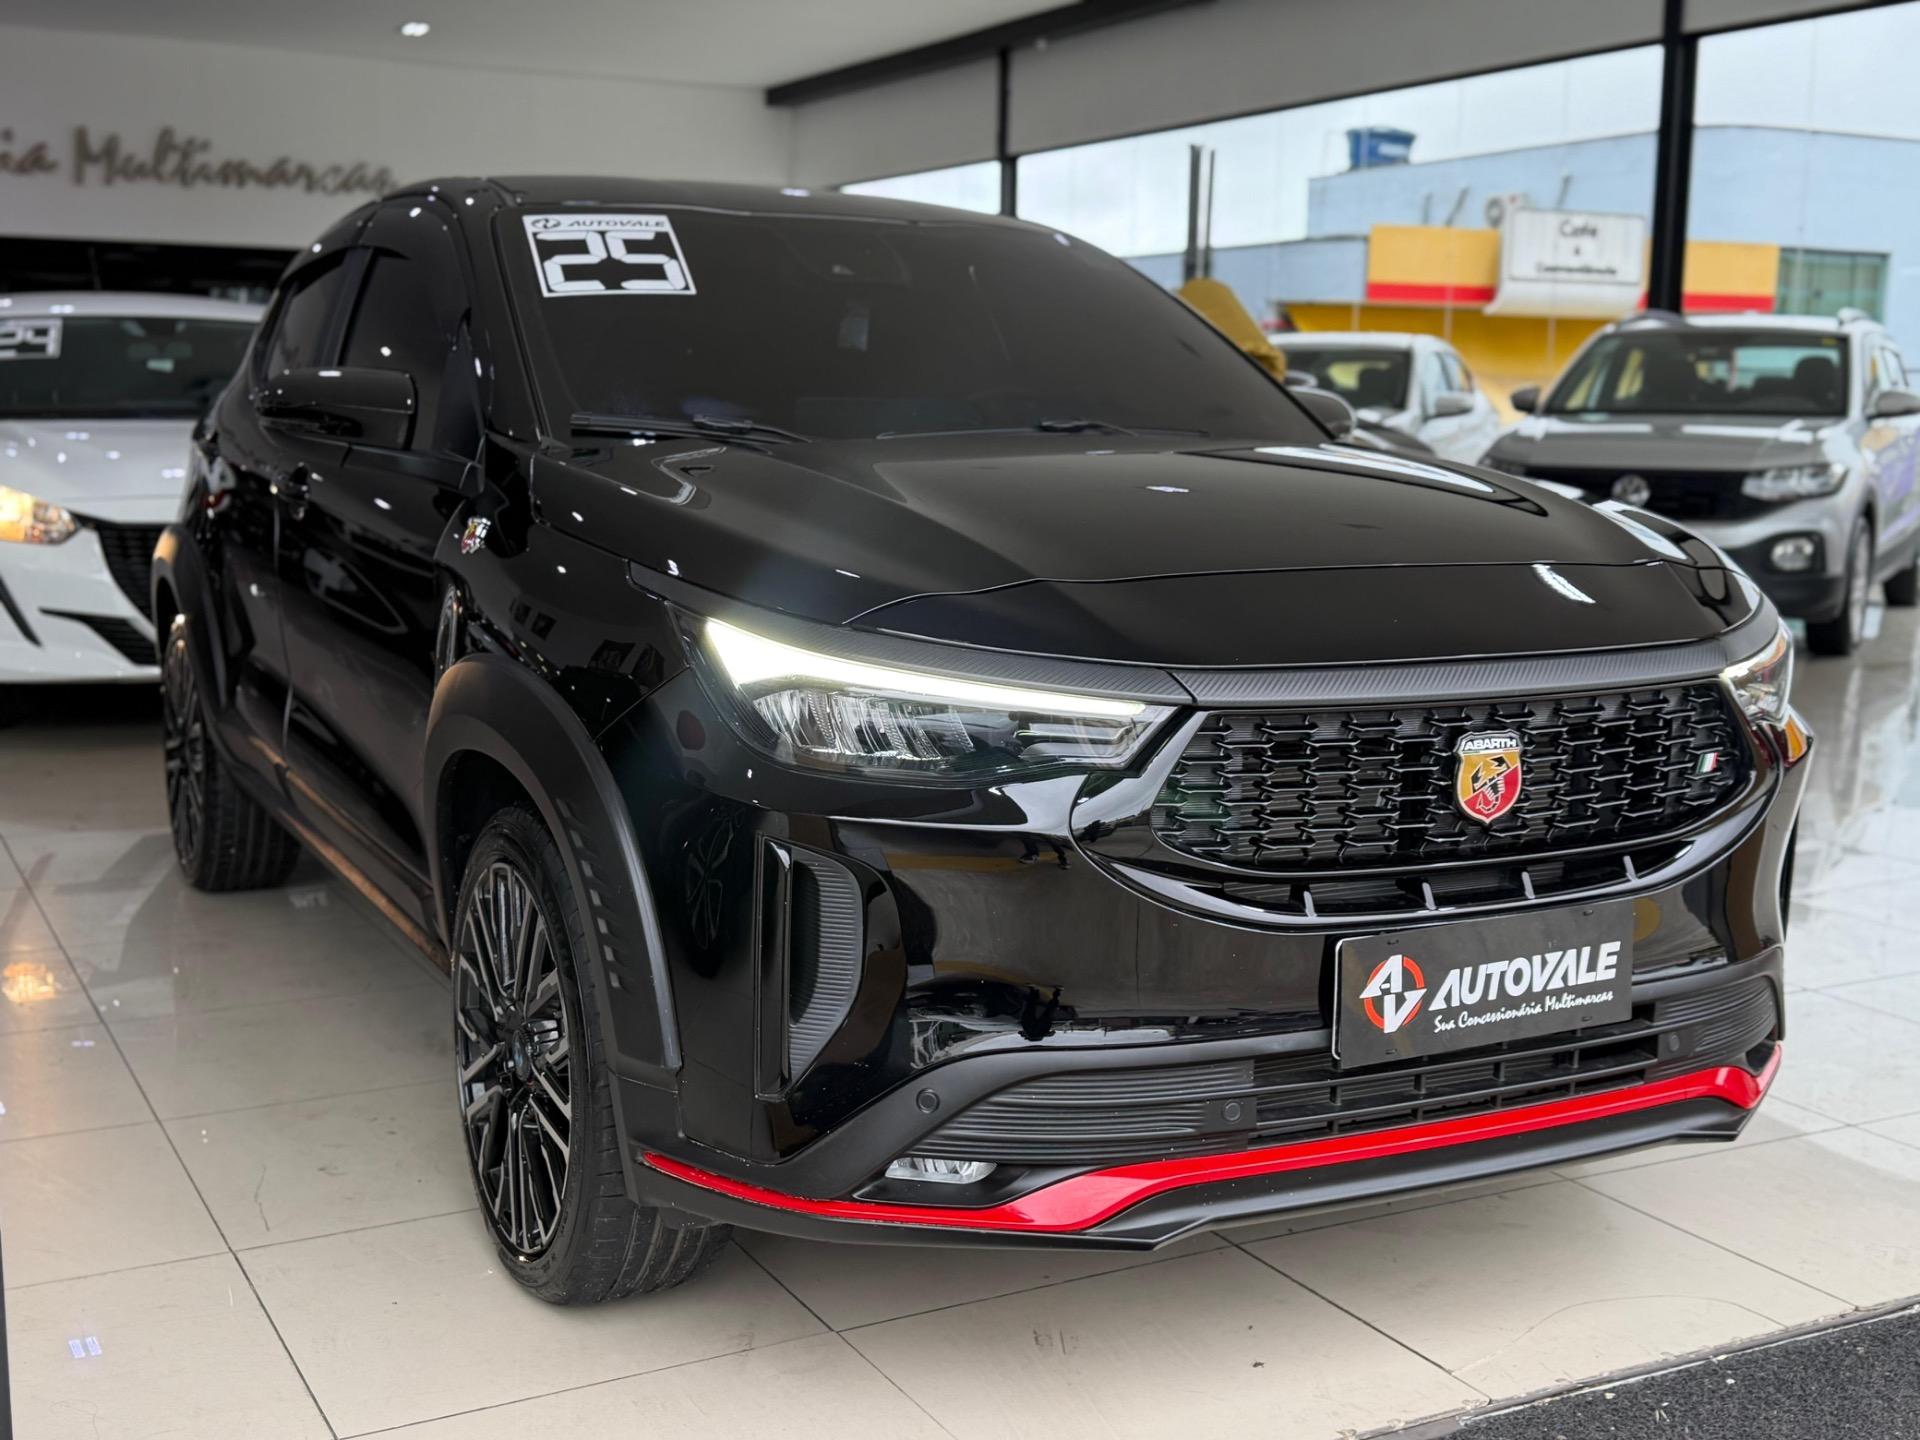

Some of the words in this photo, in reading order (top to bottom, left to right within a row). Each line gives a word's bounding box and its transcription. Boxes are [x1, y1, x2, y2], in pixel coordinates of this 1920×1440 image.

[70, 123, 398, 195] Multimarcas
[568, 219, 665, 228] AUTOVALE
[536, 230, 686, 292] 25
[1464, 738, 1517, 751] ABARTH
[1428, 940, 1622, 1011] AUTOVALE
[1433, 1014, 1457, 1033] Sua
[1458, 1002, 1543, 1028] Concessionária
[1544, 990, 1614, 1012] Multimarcas
